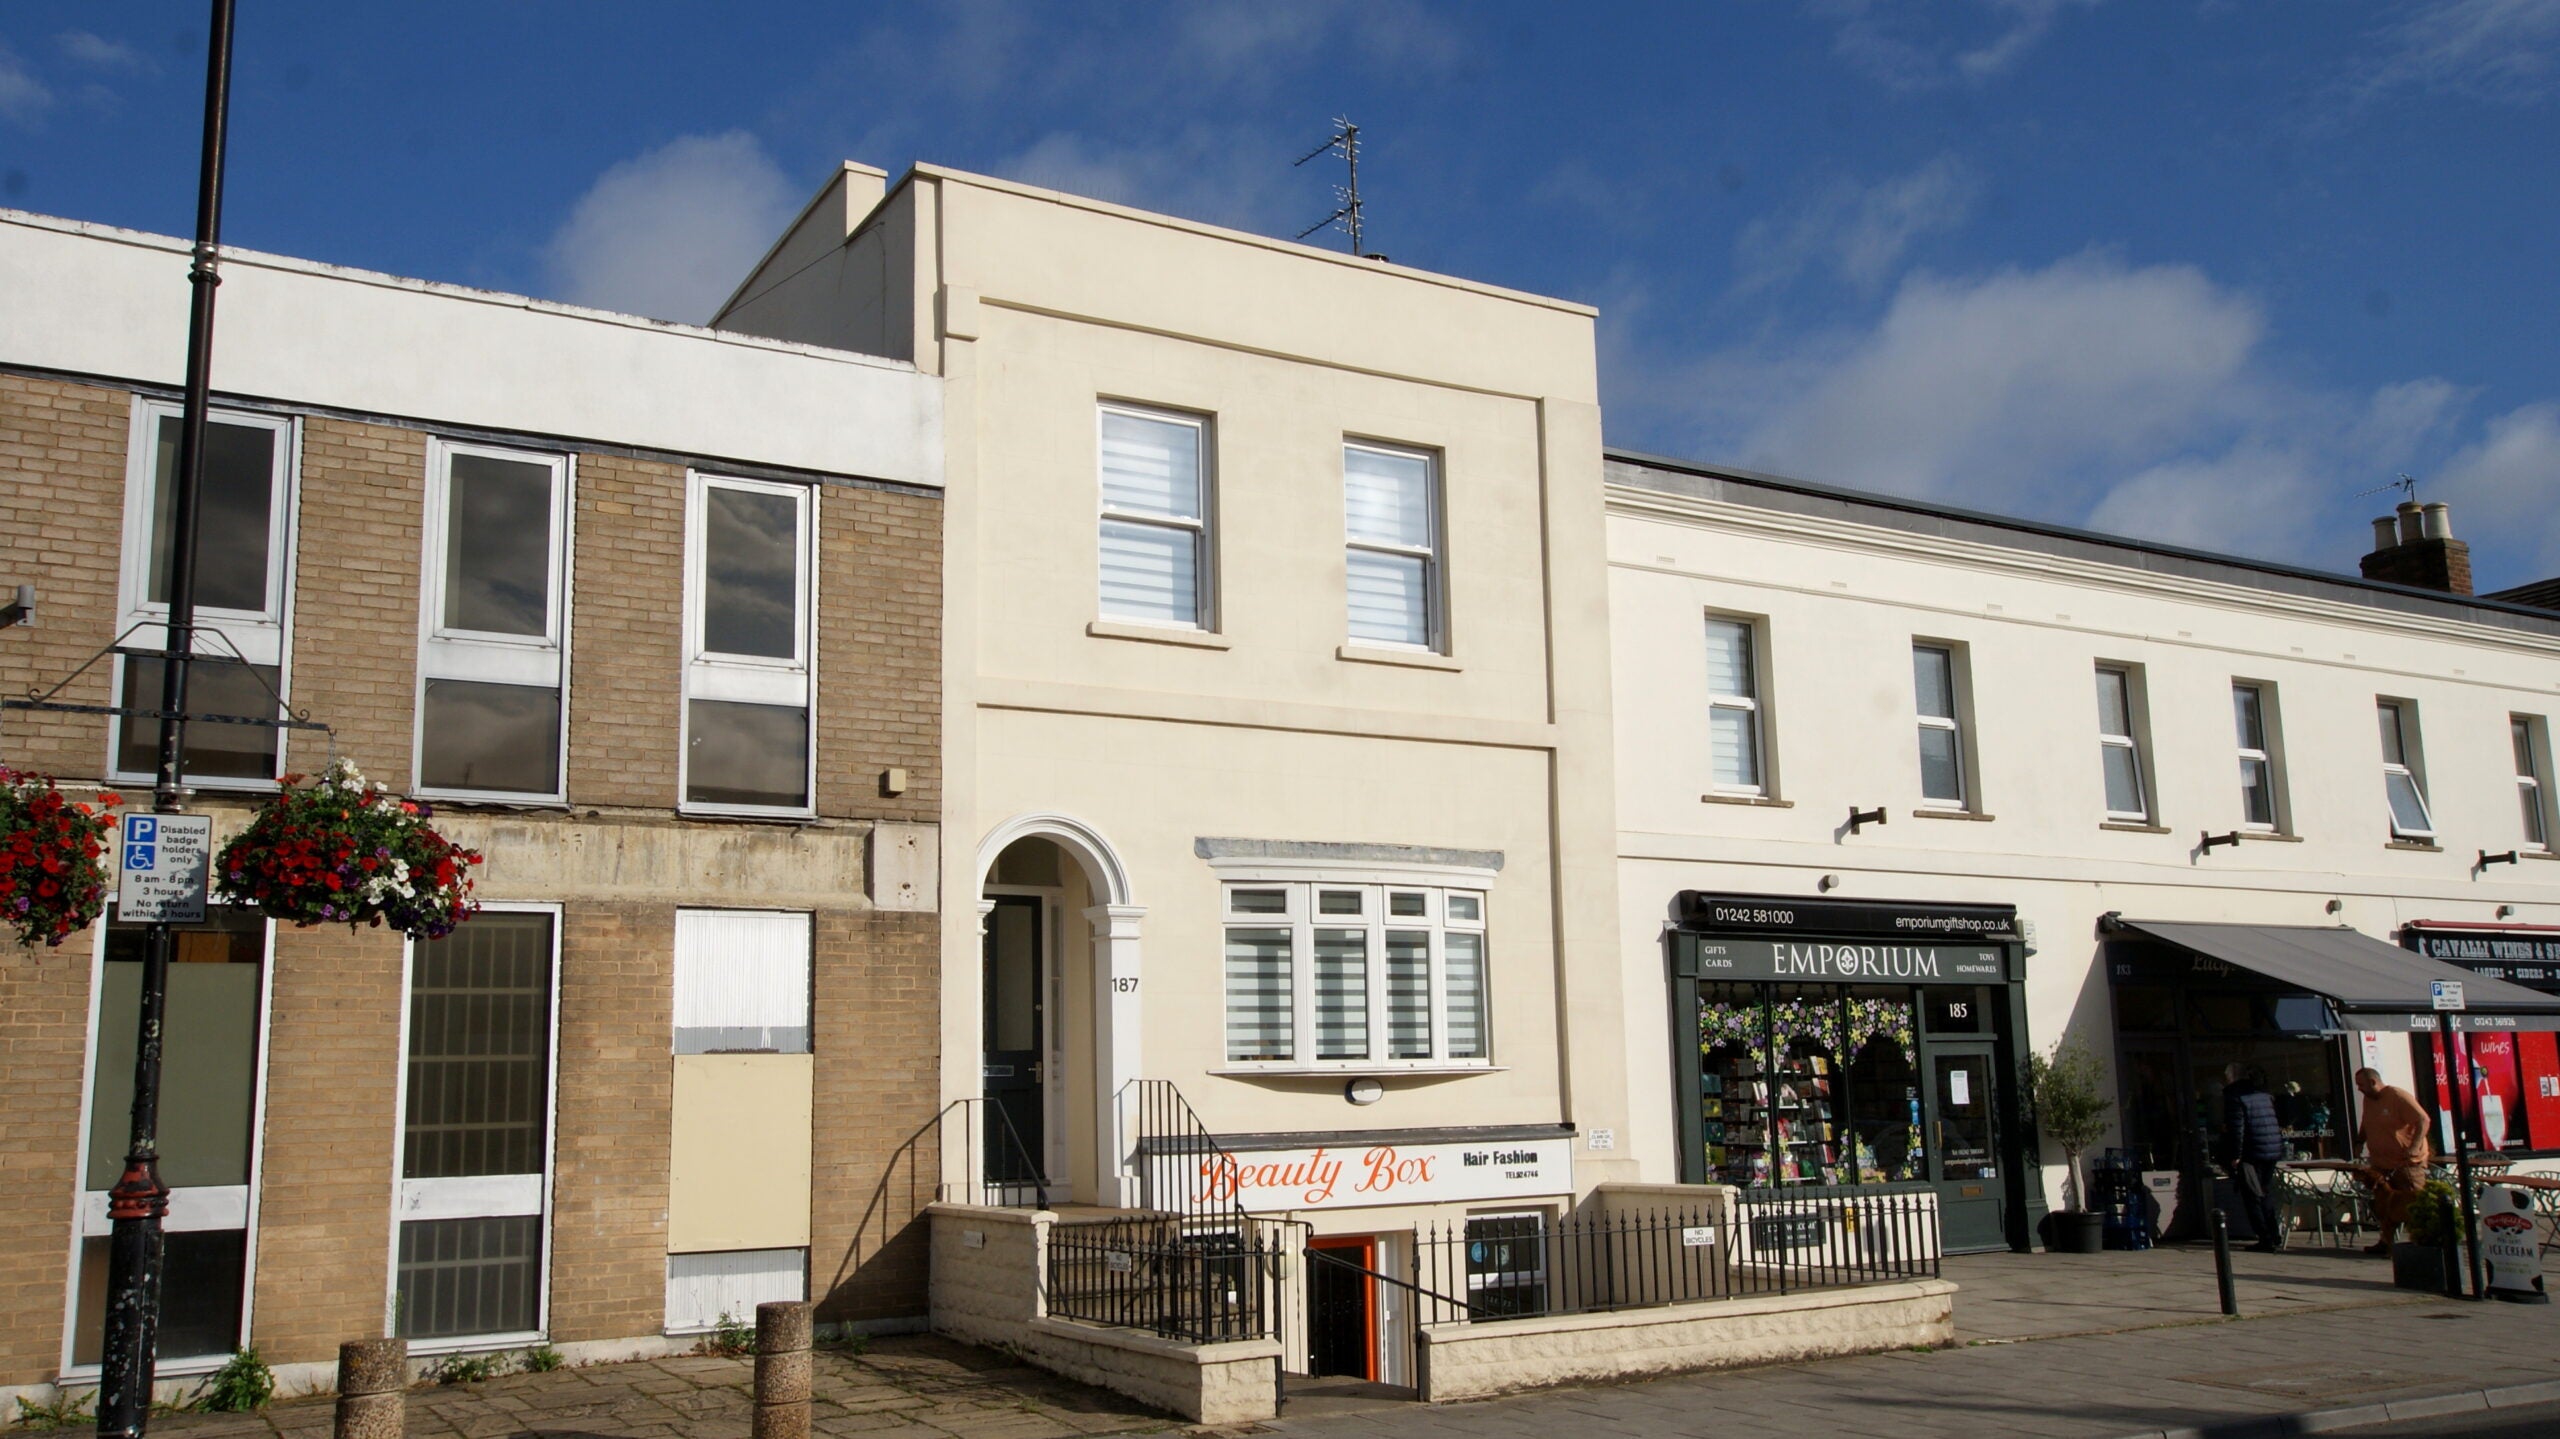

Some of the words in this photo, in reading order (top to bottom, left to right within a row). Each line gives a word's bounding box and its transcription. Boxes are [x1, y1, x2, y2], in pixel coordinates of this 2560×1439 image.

[160, 825, 206, 835] Disabled
[166, 836, 199, 845] badge
[162, 845, 201, 854] holders
[169, 855, 193, 864] only
[143, 887, 150, 895] 3
[154, 887, 185, 896] hours
[136, 899, 152, 908] No
[155, 900, 189, 908] return
[122, 909, 156, 918] within
[160, 909, 167, 918] 3
[171, 909, 201, 918] hours
[1716, 907, 1751, 922] 01242
[1753, 909, 1794, 924] 581000
[1895, 916, 2010, 932] emporiumgiftshop.co.uk
[1704, 946, 1727, 955] GIFTS
[2431, 939, 2490, 958] CAVALLI
[2491, 941, 2533, 959] WINES
[2535, 942, 2544, 960] &
[1772, 943, 1941, 977] EMPORIUM
[1979, 953, 1995, 961] TOYS
[1705, 959, 1733, 968] CARDS
[1956, 964, 1997, 973] HOMEWARES
[2516, 968, 2544, 979] CIDERS
[1111, 977, 1139, 992] 187
[1949, 1003, 1968, 1018] 185
[1463, 1151, 1489, 1167] Hair
[1493, 1149, 1538, 1165] Fashion
[1192, 1146, 1343, 1204] Beauty
[1354, 1145, 1437, 1193] Box
[1685, 1236, 1714, 1245] BICYCLES
[2505, 1245, 2535, 1258] CREAM
